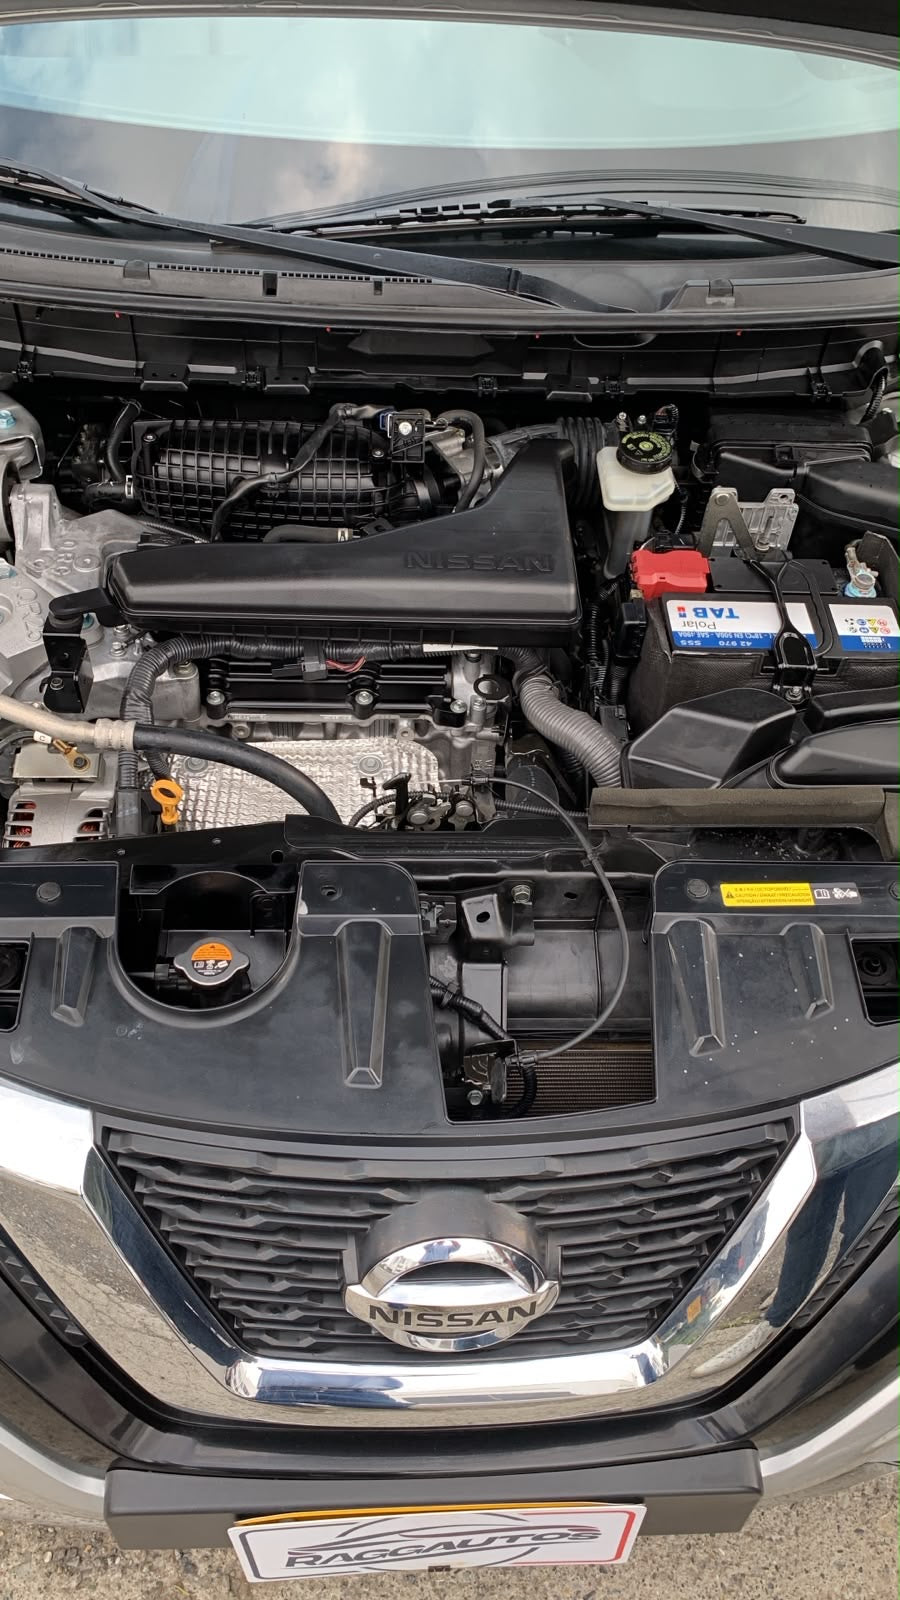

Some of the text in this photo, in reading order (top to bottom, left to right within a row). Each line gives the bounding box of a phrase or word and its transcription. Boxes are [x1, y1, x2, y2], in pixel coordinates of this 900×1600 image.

[403, 551, 553, 573] NISSAN
[692, 606, 740, 619] TAB
[682, 620, 717, 630] Polar
[369, 1301, 537, 1328] NISSAN
[285, 1532, 602, 1568] RAGGAUTOS
